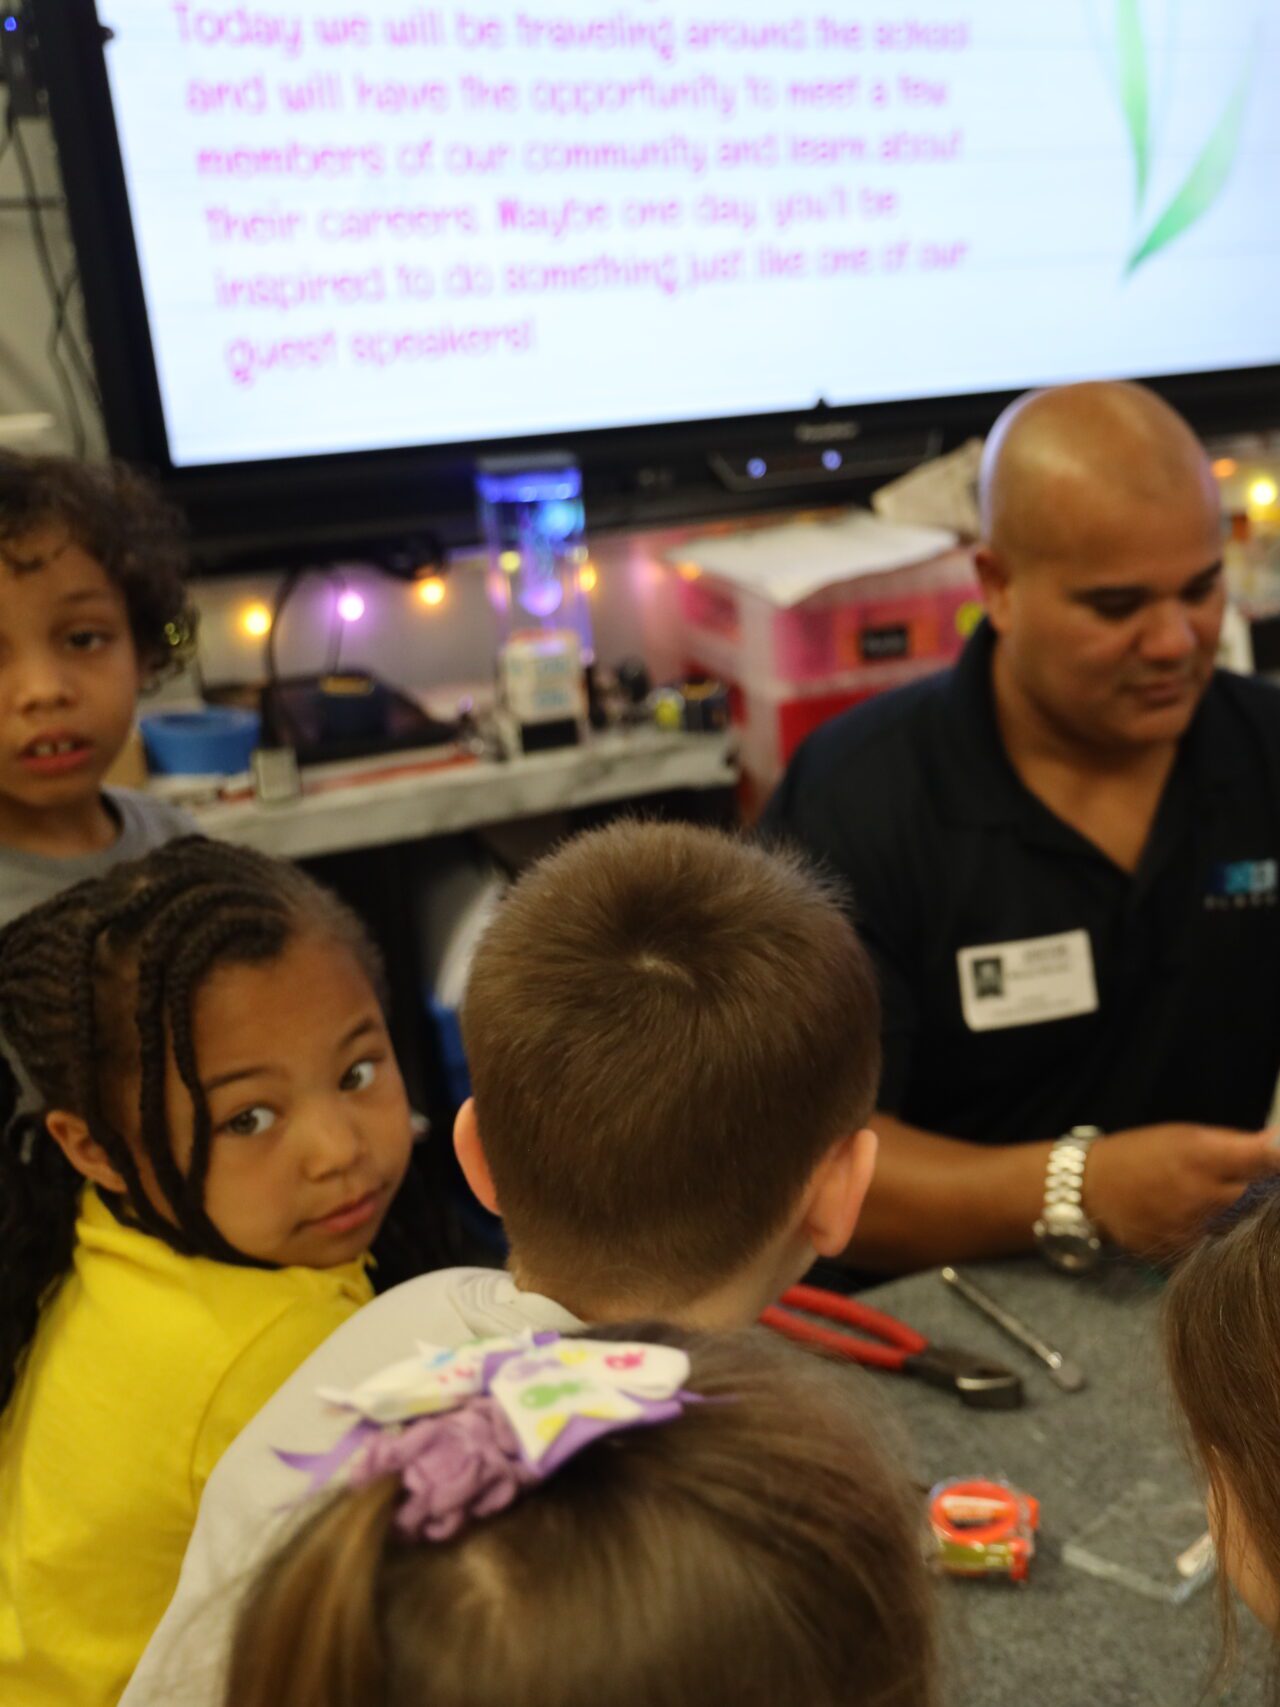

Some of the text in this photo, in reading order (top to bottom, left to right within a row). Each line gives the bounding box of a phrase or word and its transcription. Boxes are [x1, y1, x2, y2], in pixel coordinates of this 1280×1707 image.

[172, 1, 968, 58] Today we will be traveling around the school
[187, 74, 948, 115] and will have the opportunity to meet a few
[197, 131, 962, 177] members of our community and learn about
[205, 207, 302, 241] their
[498, 198, 610, 238] Maybe
[623, 200, 680, 226] one
[861, 188, 898, 217] be
[217, 244, 968, 308] inspired to do something just like one of our
[227, 332, 335, 387] guest
